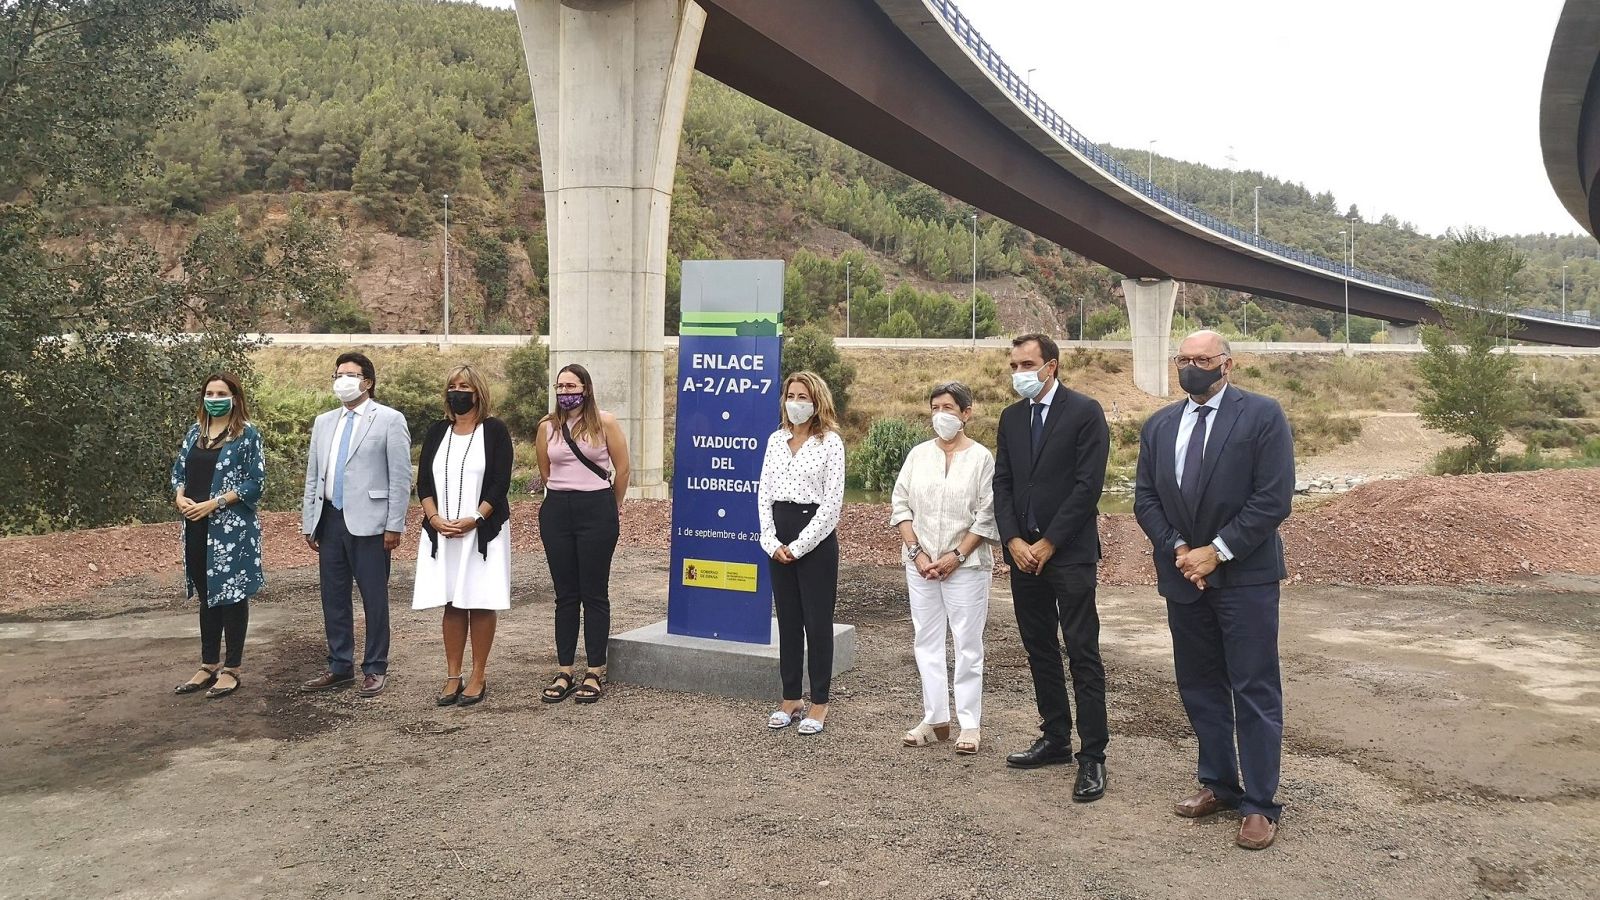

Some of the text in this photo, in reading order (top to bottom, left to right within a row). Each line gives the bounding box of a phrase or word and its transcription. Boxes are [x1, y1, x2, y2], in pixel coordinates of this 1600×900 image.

[692, 354, 764, 370] ENLACE
[682, 377, 772, 396] A-2/AP-7
[692, 436, 758, 450] VIADUCTO
[712, 457, 735, 470] DEL
[688, 476, 760, 493] LLOBREGAT
[678, 527, 760, 542] 1 de septiembre de 20
